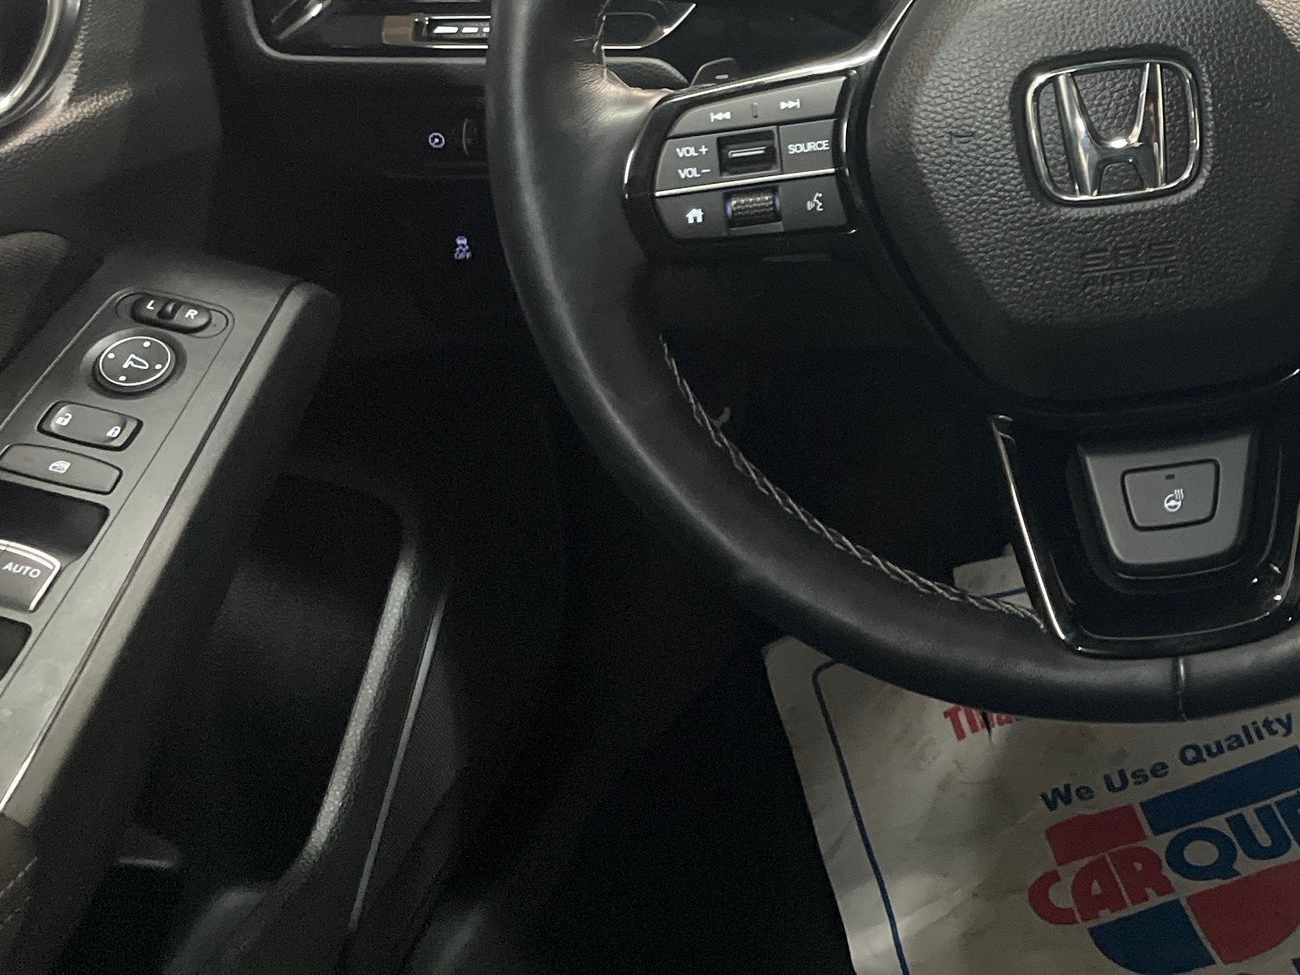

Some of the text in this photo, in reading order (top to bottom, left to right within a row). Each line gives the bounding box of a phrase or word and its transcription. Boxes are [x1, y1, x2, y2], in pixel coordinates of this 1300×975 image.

[787, 139, 830, 155] SOURCE
[146, 299, 155, 310] L
[185, 309, 199, 320] R
[2, 561, 42, 579] AUTO
[1040, 712, 1294, 811] We Use Quality
